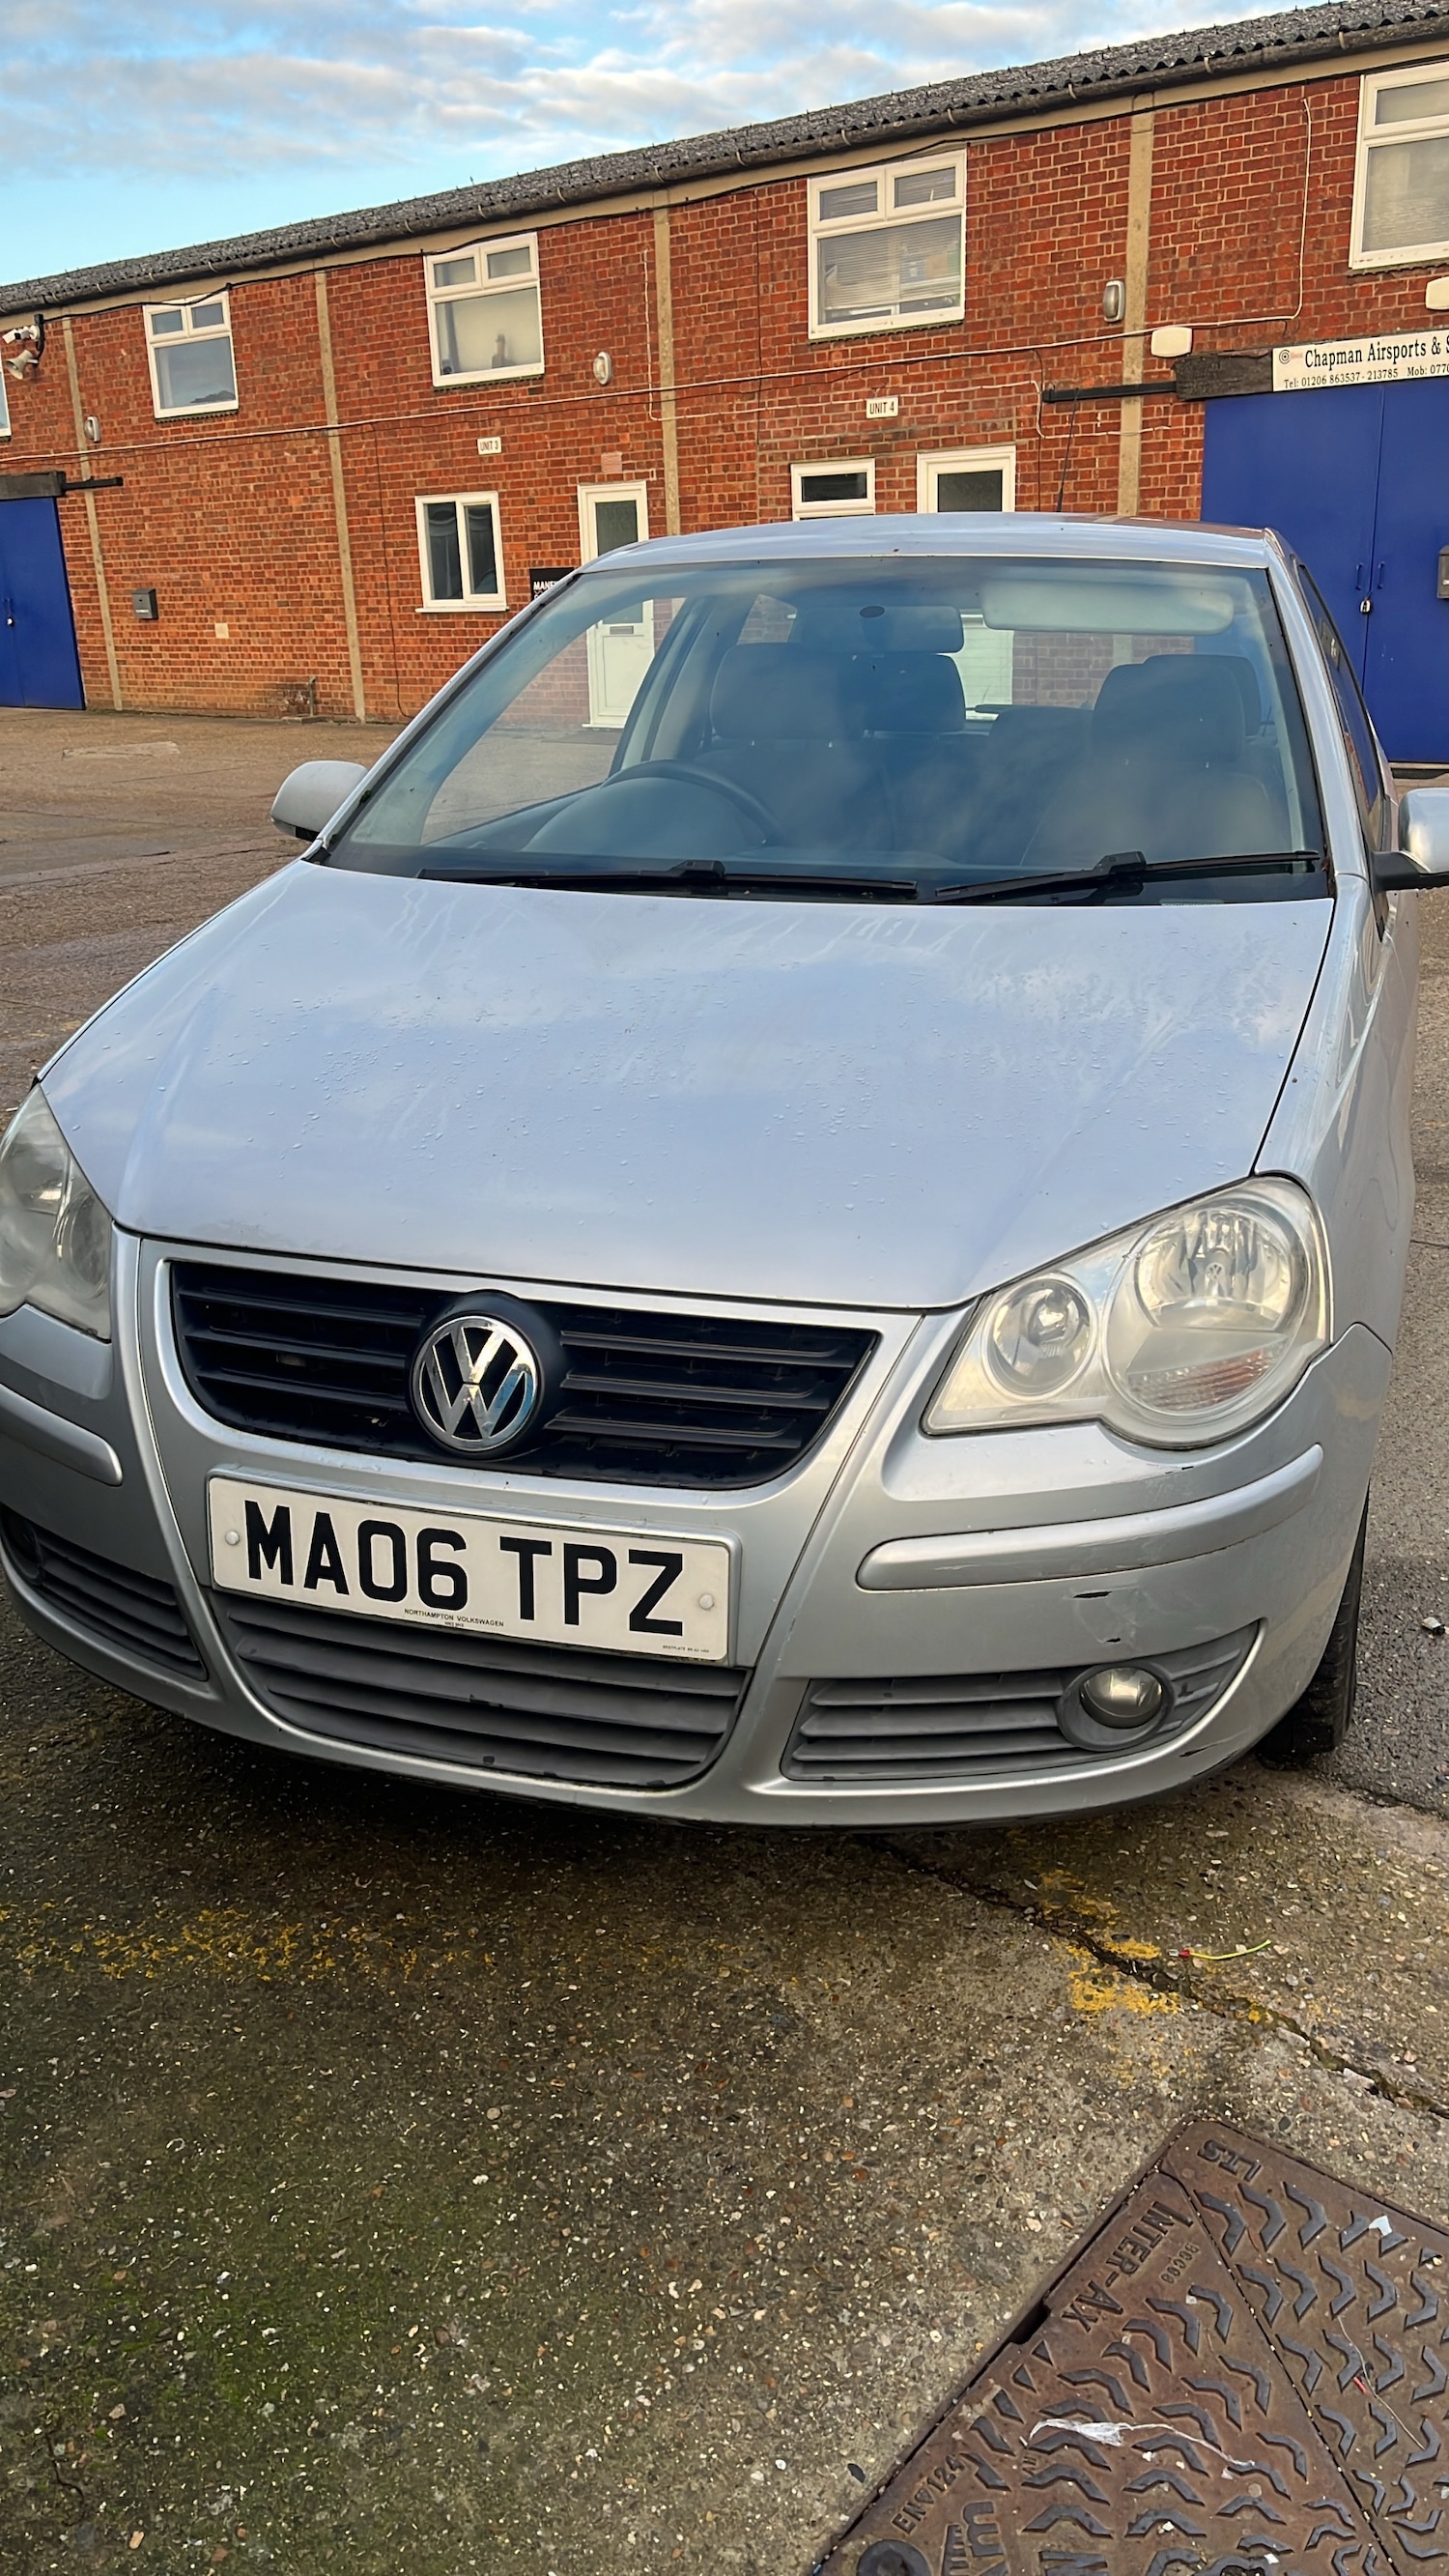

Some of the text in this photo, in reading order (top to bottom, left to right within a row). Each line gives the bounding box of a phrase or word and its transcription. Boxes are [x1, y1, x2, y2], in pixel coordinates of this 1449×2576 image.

[1305, 348, 1363, 371] Chapman
[1367, 339, 1427, 364] Airsports
[1431, 336, 1441, 356] &
[1284, 379, 1299, 388] Tel:
[1301, 375, 1327, 387] 01206
[1329, 371, 1361, 385] 863537
[1367, 368, 1399, 381] 213785
[1406, 365, 1428, 377] Mob:
[869, 401, 895, 415] UNIT 4
[480, 440, 499, 451] UNIT 3
[412, 1315, 537, 1451] VW
[244, 1500, 684, 1637] MA06 TPZ
[404, 1608, 454, 1621] NORTHAMPTON
[456, 1616, 504, 1627] VOLKSWAGEN
